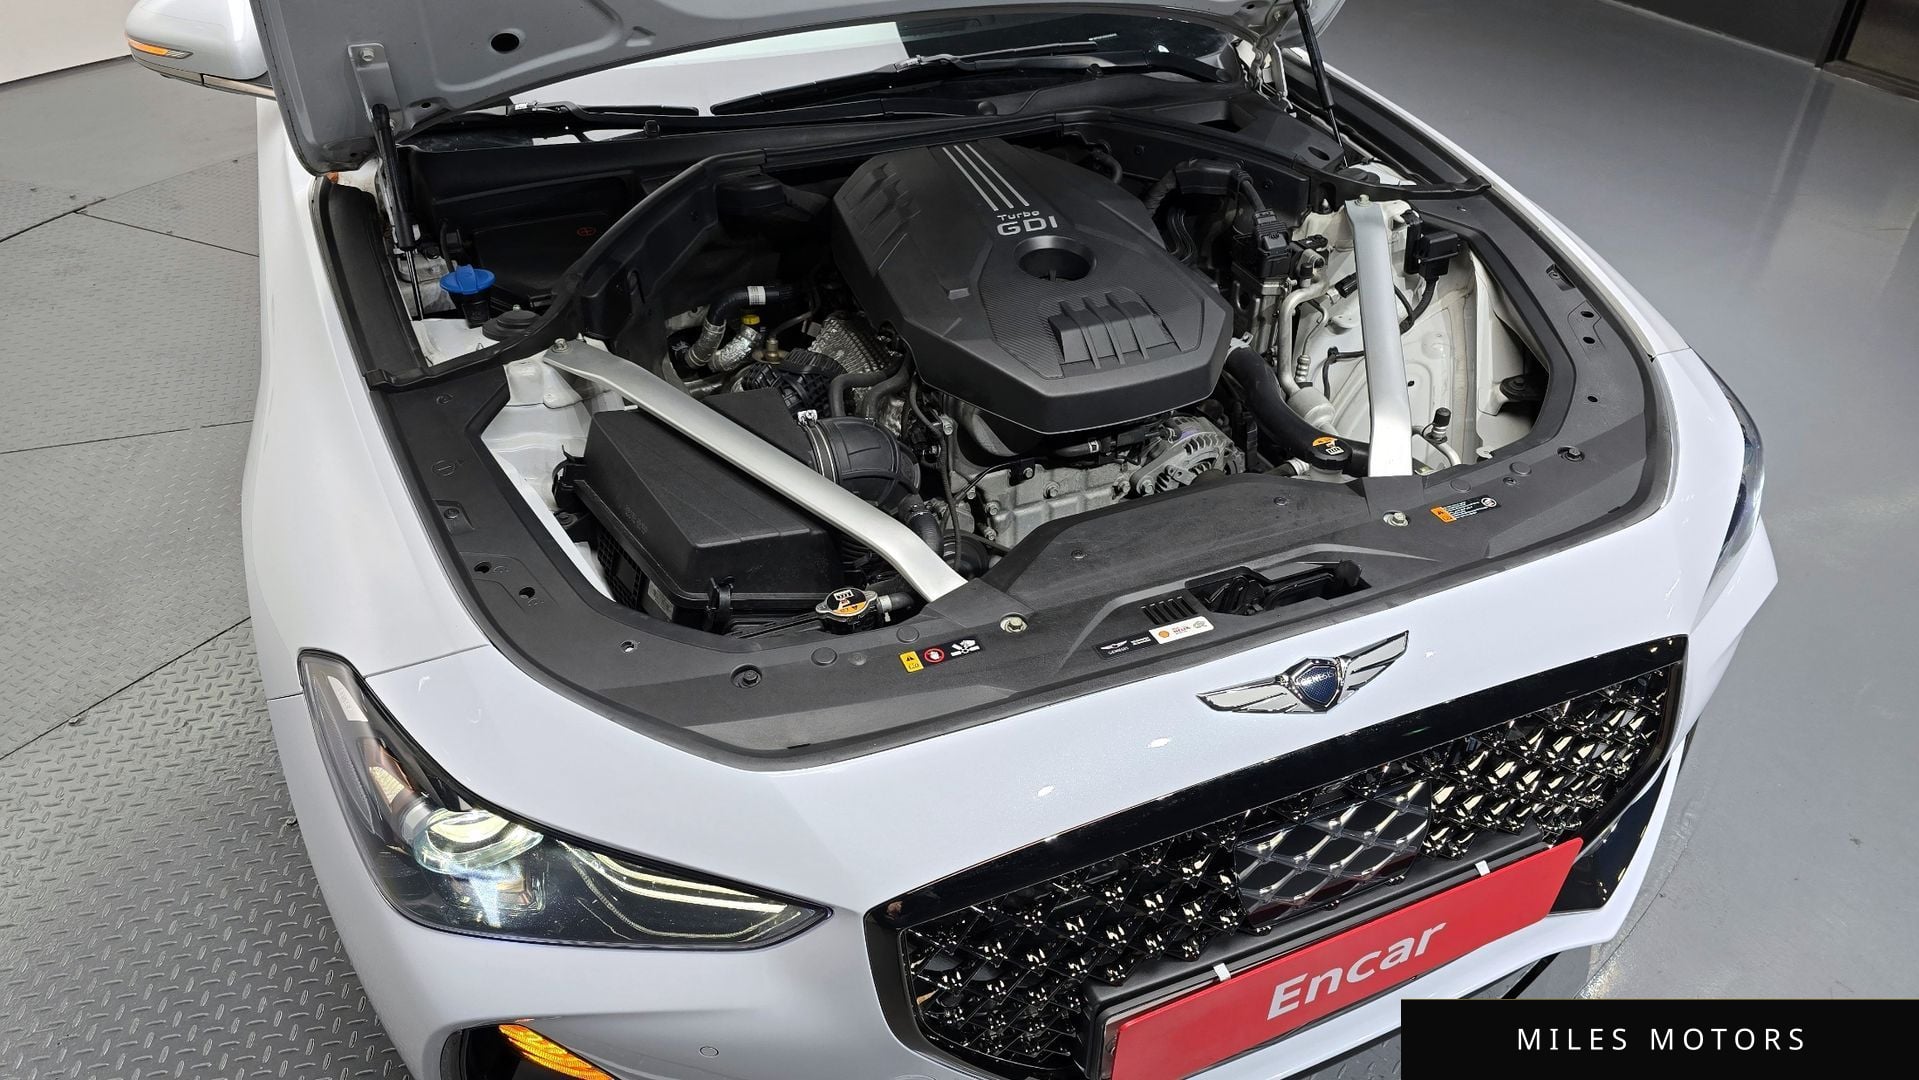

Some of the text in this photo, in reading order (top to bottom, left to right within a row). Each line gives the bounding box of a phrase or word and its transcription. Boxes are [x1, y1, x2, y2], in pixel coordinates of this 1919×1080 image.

[997, 210, 1040, 221] Turbo
[997, 215, 1058, 236] GDI
[1267, 922, 1447, 1021] Encar
